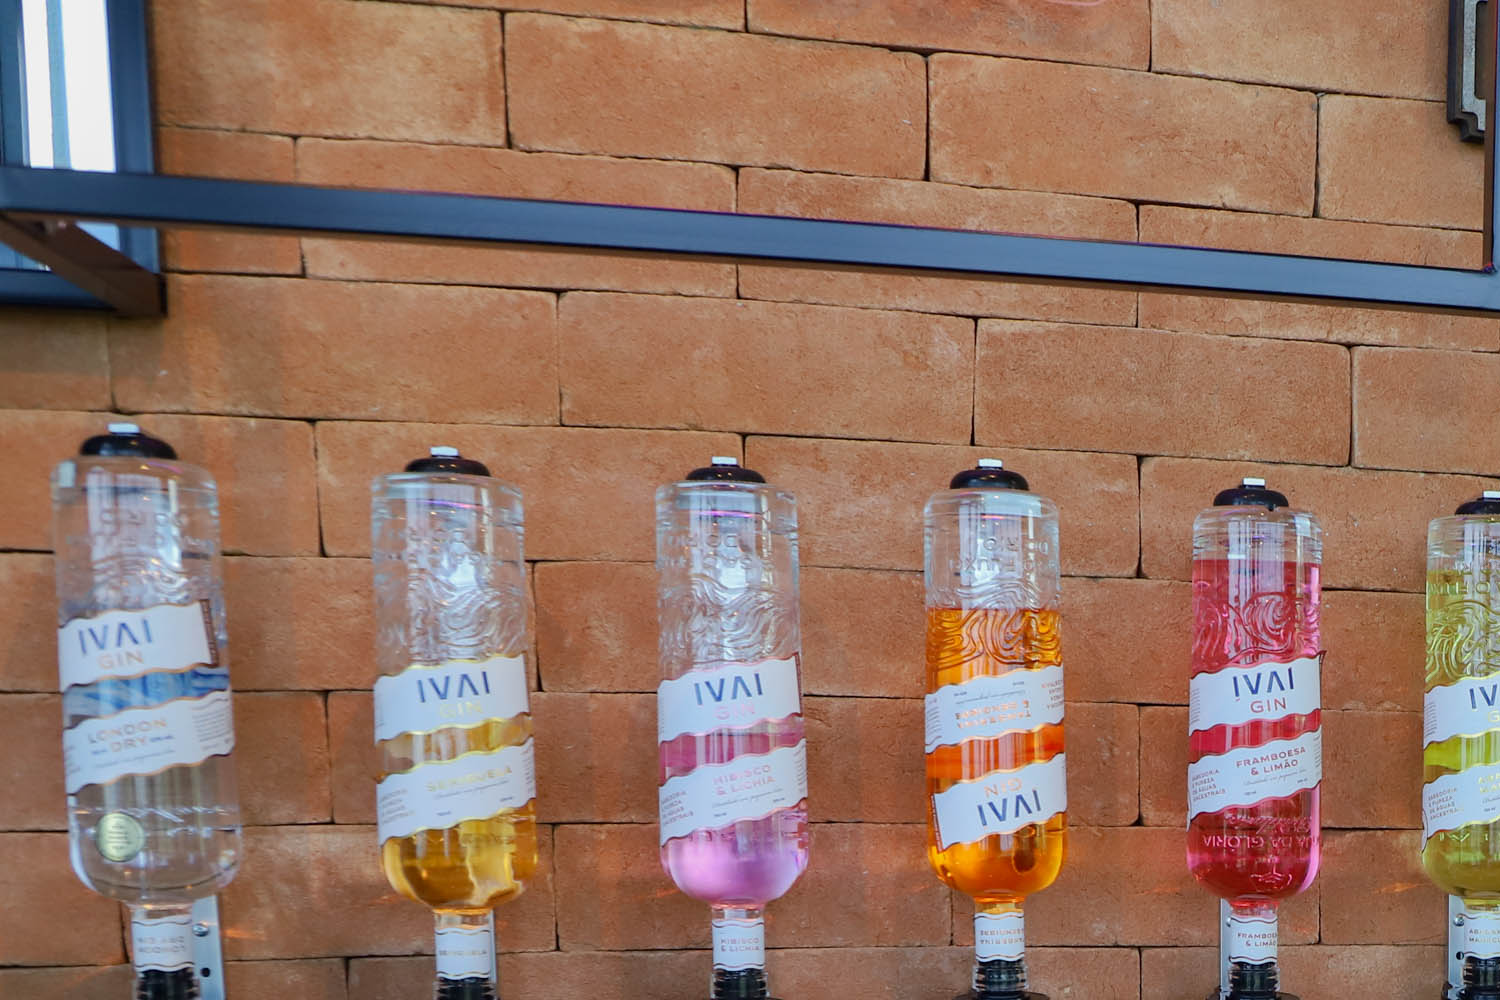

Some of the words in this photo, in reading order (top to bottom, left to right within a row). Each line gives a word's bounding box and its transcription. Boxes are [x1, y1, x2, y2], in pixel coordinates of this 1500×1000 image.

[100, 652, 144, 670] GIN
[438, 700, 483, 719] GIN
[713, 701, 756, 720] GIN
[1250, 697, 1286, 713] GIN
[88, 717, 167, 744] LONDON
[110, 735, 148, 752] DRY
[1236, 746, 1306, 768] FRAMBOESA
[1250, 767, 1259, 776] &
[1263, 758, 1298, 773] LIMÃO
[983, 778, 1023, 798] GIN
